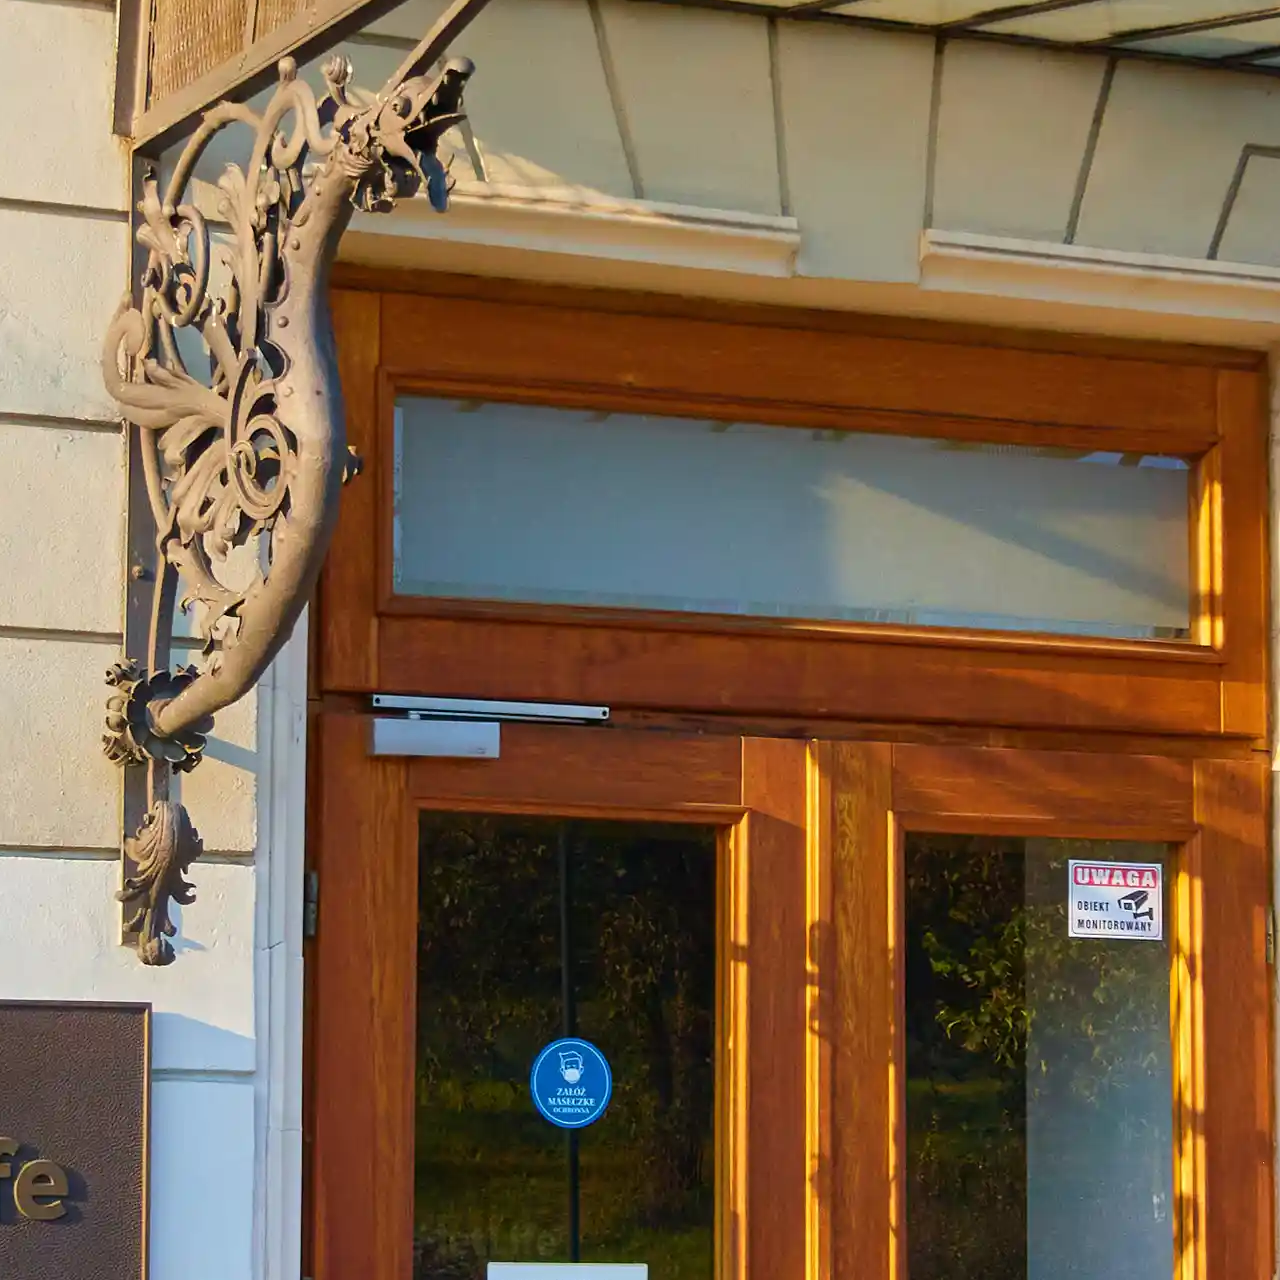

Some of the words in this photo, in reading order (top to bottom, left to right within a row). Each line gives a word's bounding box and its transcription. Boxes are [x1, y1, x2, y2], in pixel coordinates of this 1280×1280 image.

[1075, 868, 1156, 888] UWAGA
[1077, 900, 1110, 912] OBIEKT
[1077, 918, 1152, 932] MONITOROWANY
